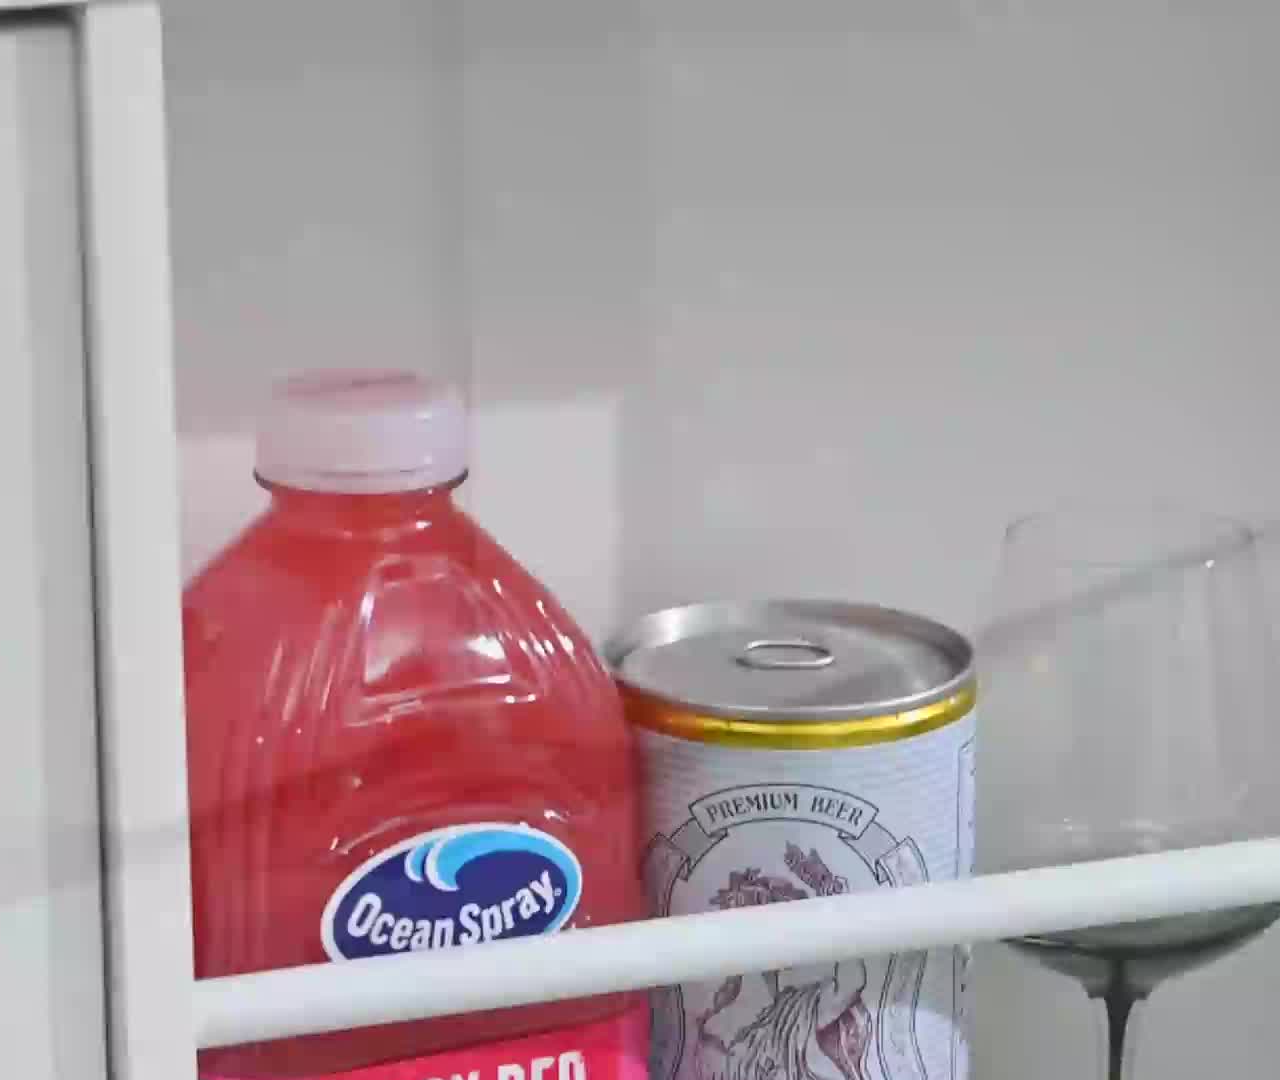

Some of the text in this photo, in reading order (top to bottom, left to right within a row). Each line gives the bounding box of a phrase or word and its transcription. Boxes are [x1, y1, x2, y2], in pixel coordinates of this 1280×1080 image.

[705, 792, 864, 827] PREMIUM BEER
[347, 869, 554, 950] Ocean Spray
